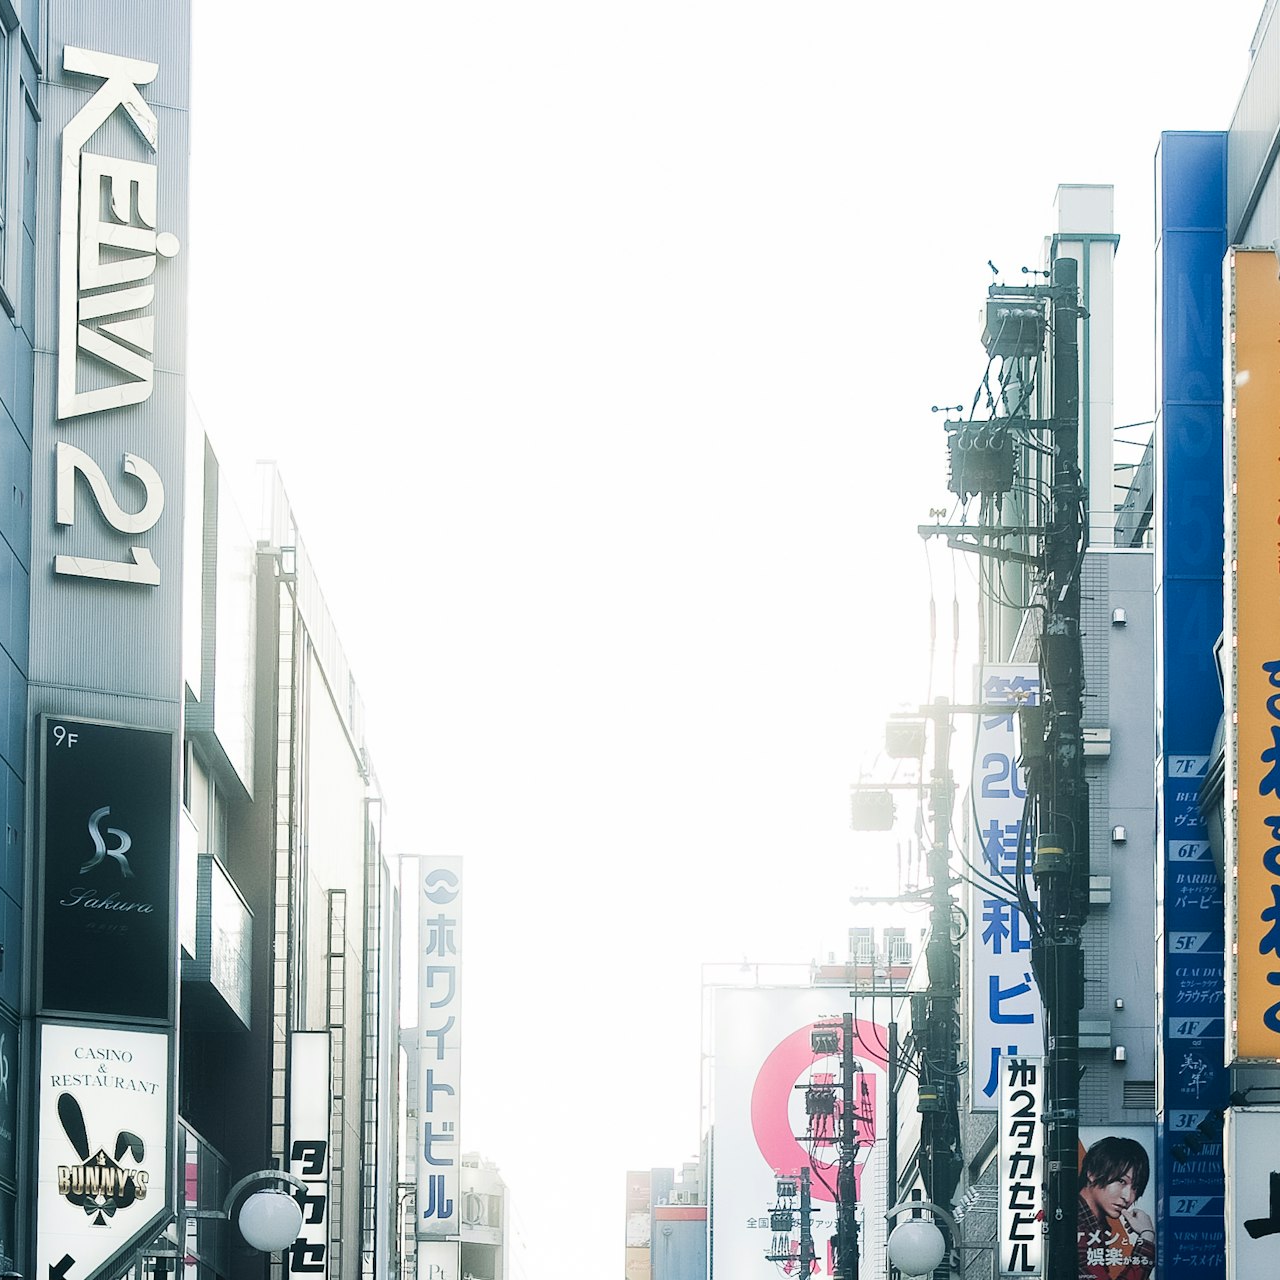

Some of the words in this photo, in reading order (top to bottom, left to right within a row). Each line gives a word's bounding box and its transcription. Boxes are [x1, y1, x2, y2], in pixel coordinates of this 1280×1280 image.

[52, 723, 80, 751] 9F
[1176, 759, 1196, 773] 7F
[1178, 844, 1200, 858] 6F
[59, 886, 155, 914] Sakura
[1175, 936, 1197, 950] 5F
[1177, 1020, 1200, 1036] 4F
[73, 1045, 134, 1064] CASINO
[96, 1062, 108, 1075] &
[422, 912, 460, 1222] ホワイトビル
[50, 1073, 160, 1097] RESTAURANT
[1176, 1113, 1198, 1128] 3F
[57, 1163, 150, 1201] BUNNY'S
[1176, 1200, 1199, 1214] 2F
[1086, 1247, 1154, 1267] 娯楽がある。
[1172, 1253, 1223, 1267] ナースメイド
[429, 1263, 446, 1280] Pt
